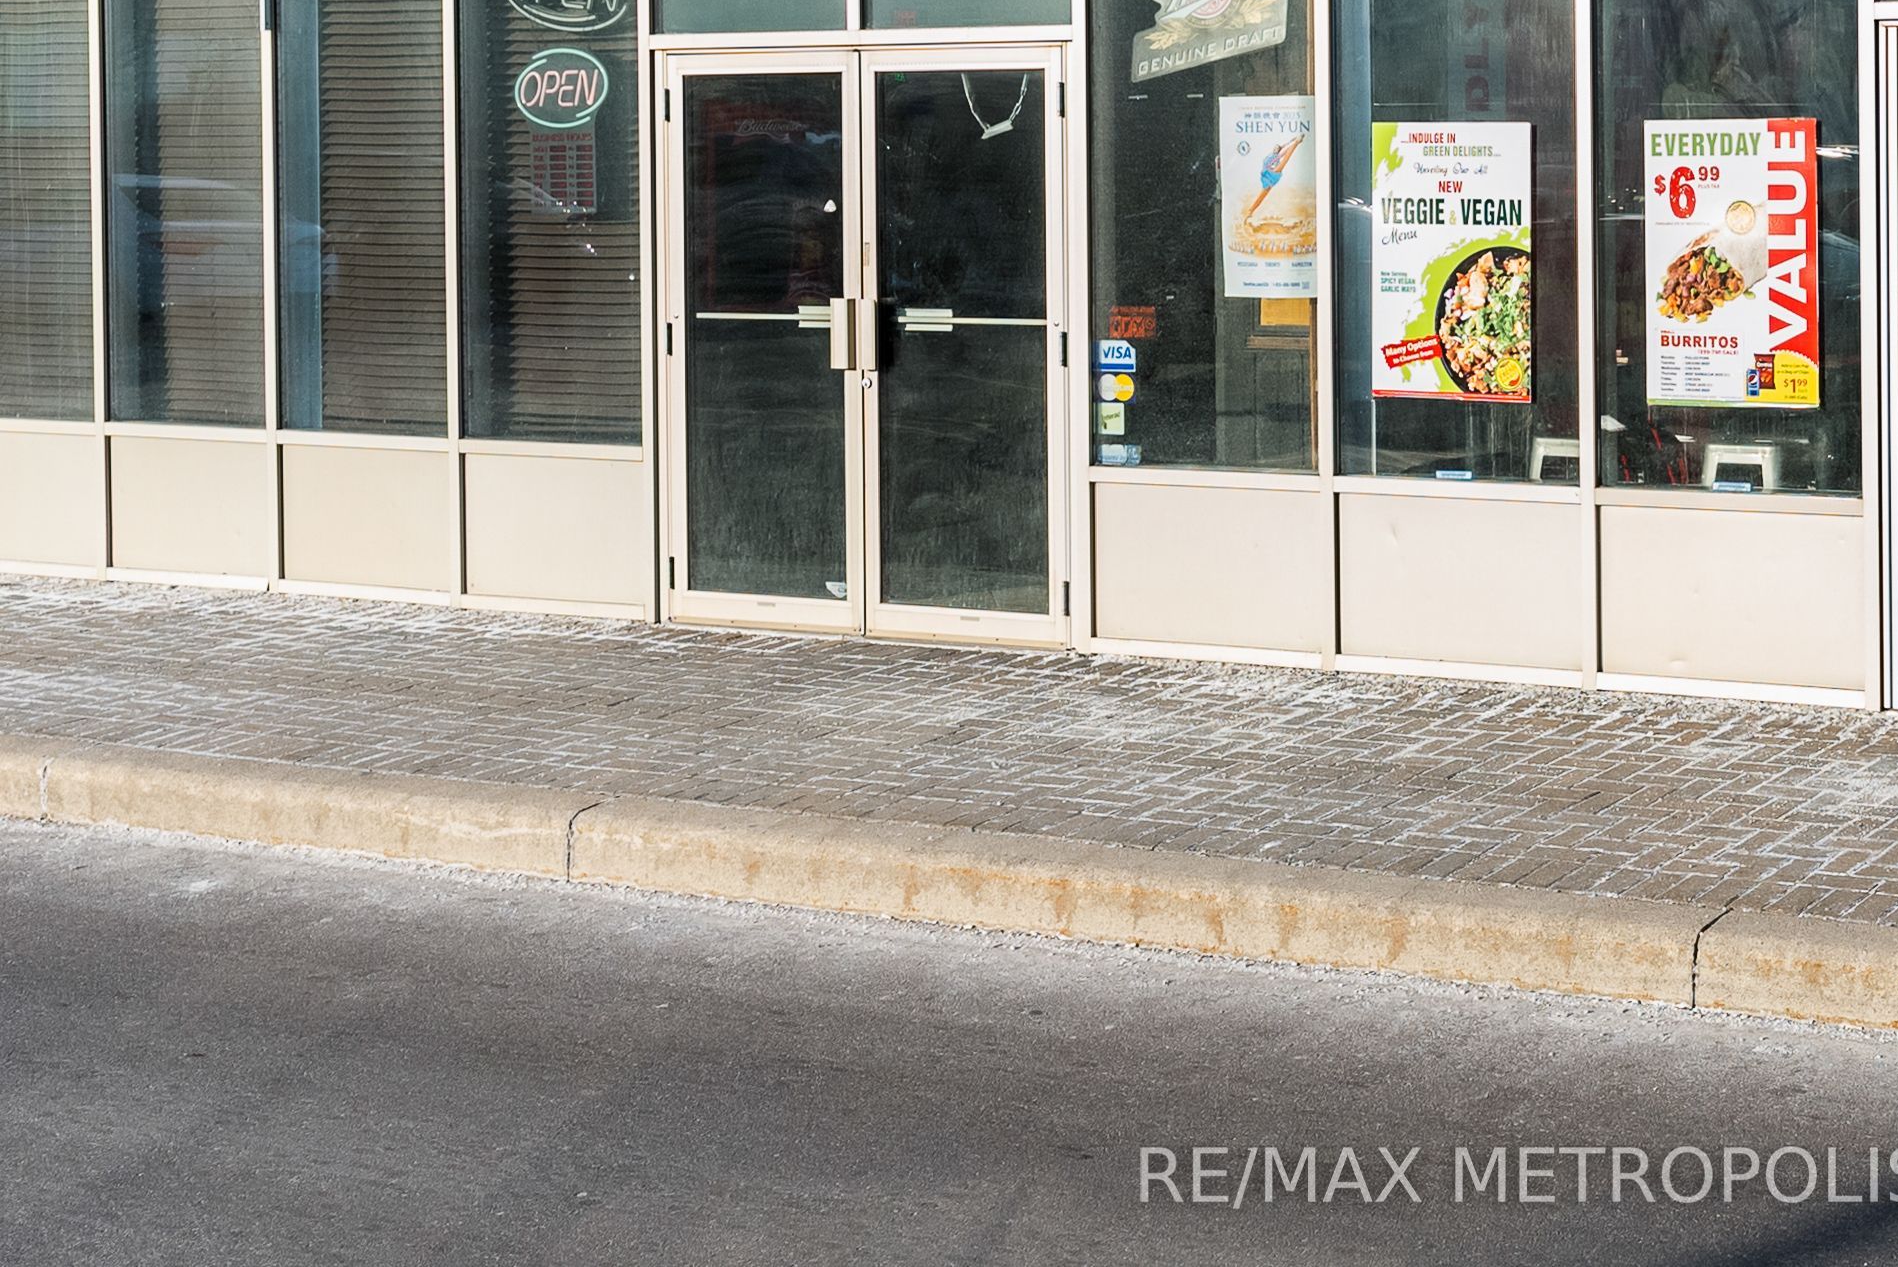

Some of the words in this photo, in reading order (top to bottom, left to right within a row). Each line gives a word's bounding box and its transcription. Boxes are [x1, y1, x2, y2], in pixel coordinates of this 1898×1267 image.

[1138, 43, 1217, 76] GENUINE
[1224, 25, 1282, 53] DRAFT
[520, 69, 599, 107] OPEN
[1235, 121, 1273, 133] SHEN
[1279, 120, 1311, 133] YUN
[1447, 133, 1456, 144] IN
[1650, 131, 1761, 157] EVERYDAY
[1423, 146, 1450, 157] GREEN
[1438, 181, 1463, 193] NEW
[1382, 198, 1445, 225] VEGGIE
[1450, 210, 1457, 226] &
[1461, 199, 1522, 226] VEGAN
[1382, 228, 1418, 245] Menu
[1767, 130, 1808, 353] VALUE
[1385, 344, 1407, 357] Many
[1407, 337, 1438, 352] Options
[1660, 334, 1739, 349] BURRITOS
[1103, 346, 1132, 360] VISA
